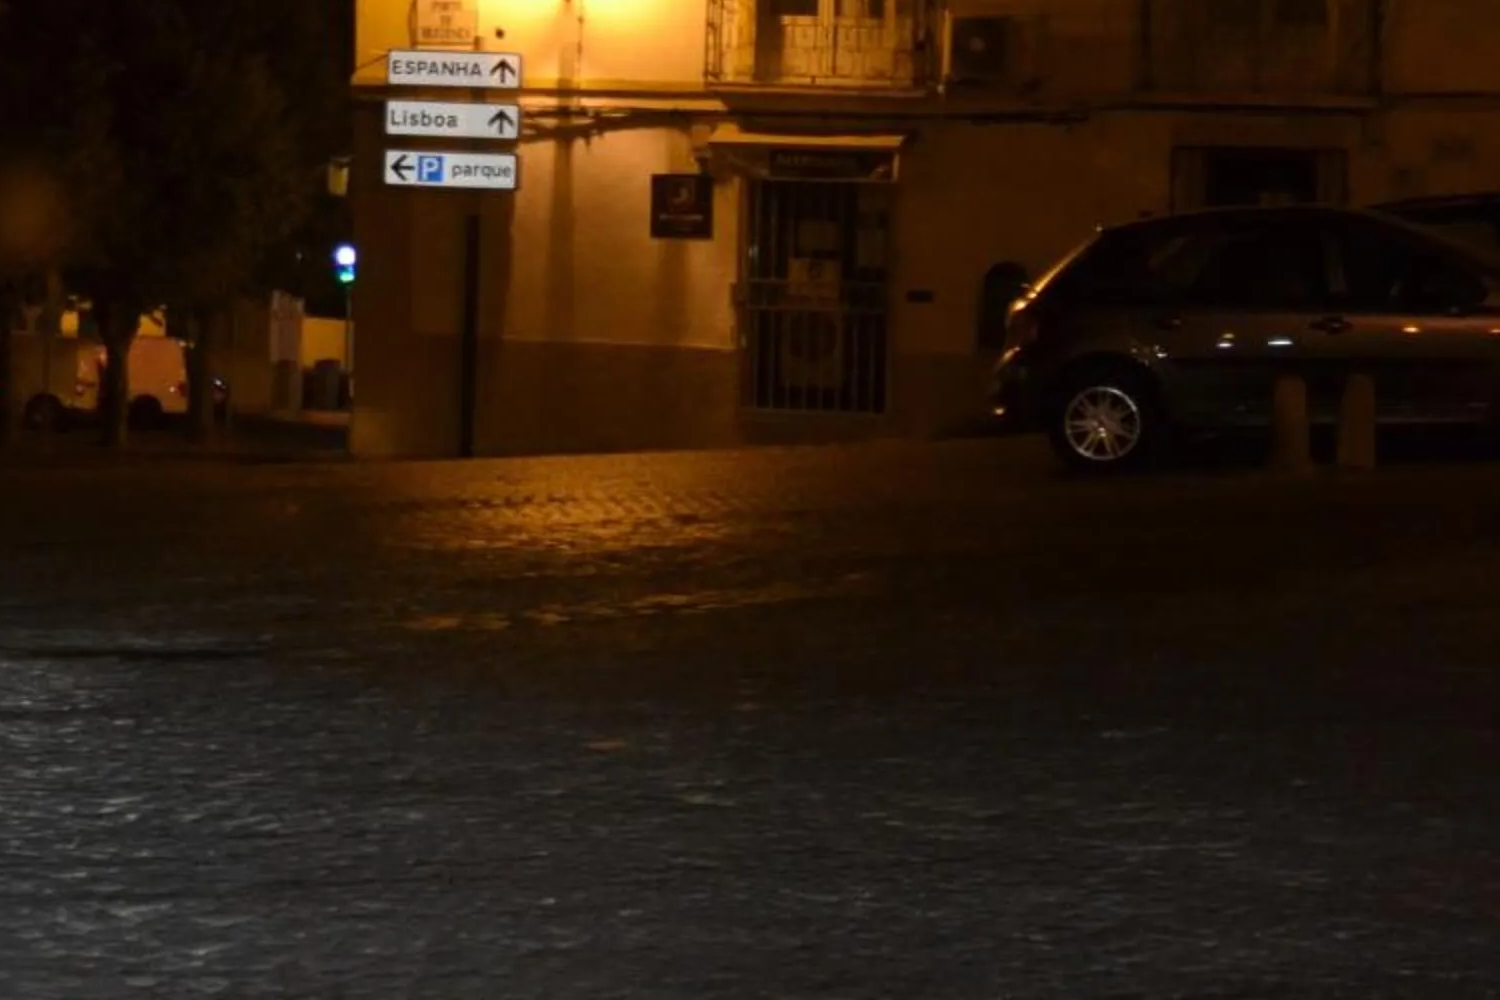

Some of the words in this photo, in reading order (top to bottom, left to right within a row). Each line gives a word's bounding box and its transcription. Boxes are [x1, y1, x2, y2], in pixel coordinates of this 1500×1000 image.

[392, 60, 481, 76] ESPANHA
[391, 110, 458, 128] Lisboa
[421, 158, 438, 180] P
[452, 164, 511, 179] parque
